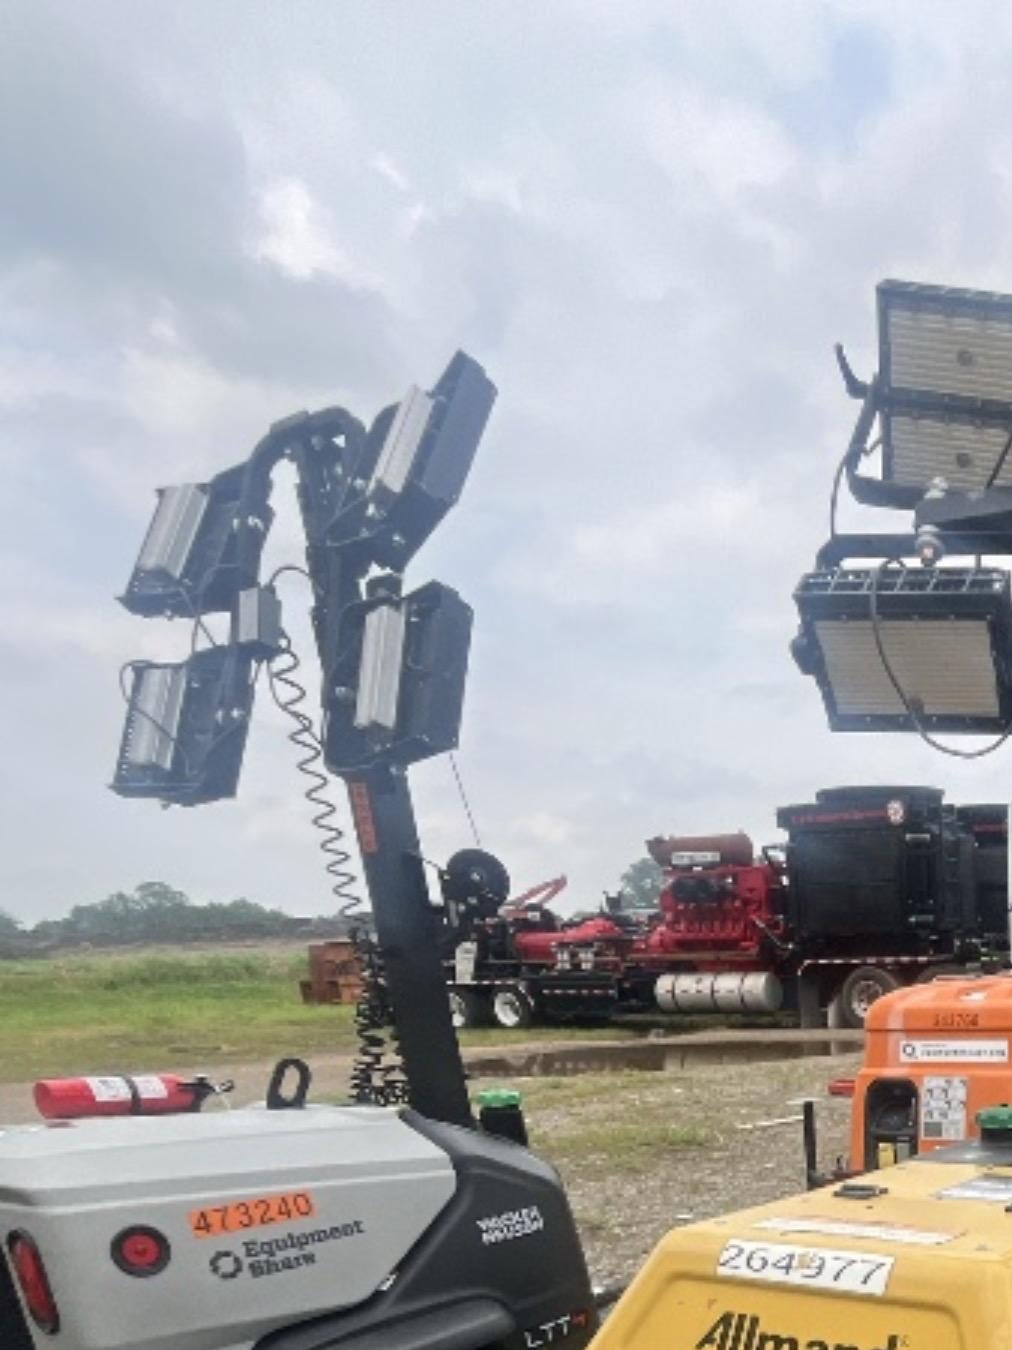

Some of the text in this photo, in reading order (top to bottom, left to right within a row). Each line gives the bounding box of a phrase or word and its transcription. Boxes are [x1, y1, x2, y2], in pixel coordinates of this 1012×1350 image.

[194, 1193, 313, 1234] 473240
[242, 1220, 366, 1259] Equipment
[719, 1244, 887, 1286] 264977
